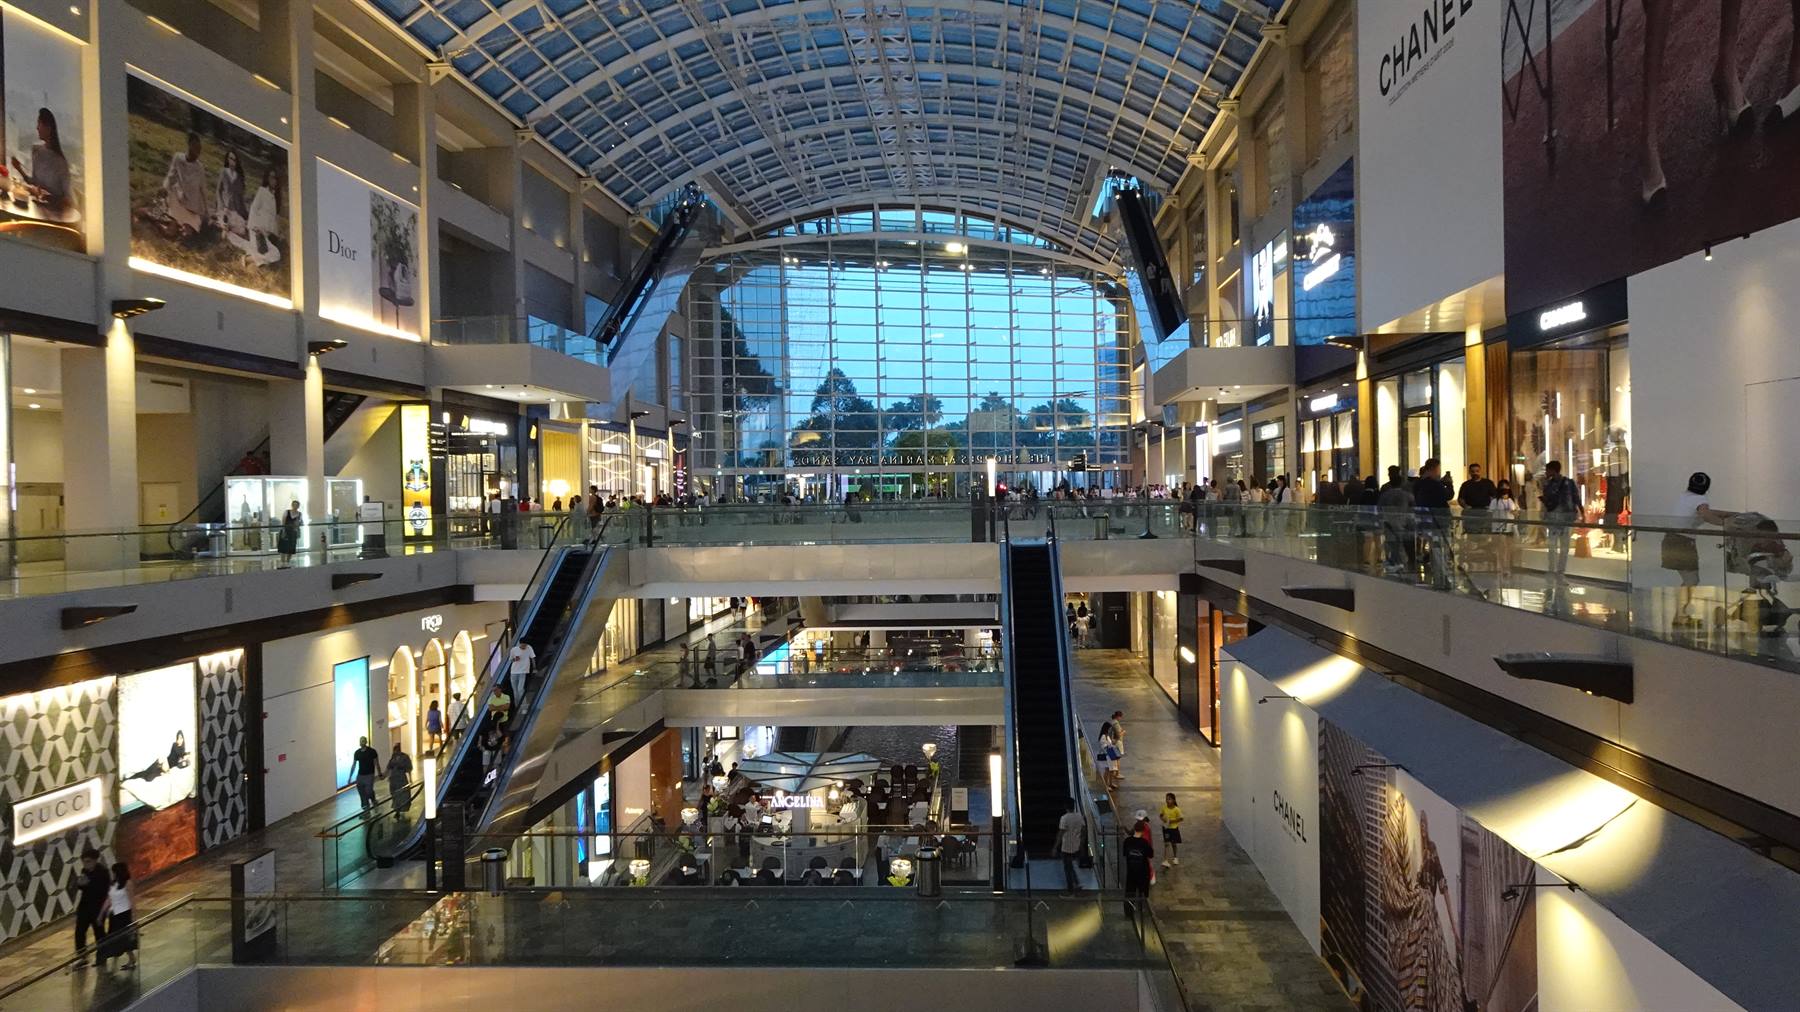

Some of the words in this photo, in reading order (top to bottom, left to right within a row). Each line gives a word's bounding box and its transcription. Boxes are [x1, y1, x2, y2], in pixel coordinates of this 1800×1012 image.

[328, 229, 357, 260] Dior
[21, 791, 91, 829] GUCCI
[770, 795, 824, 808] ANGELINA
[1273, 789, 1307, 843] CHANEL
